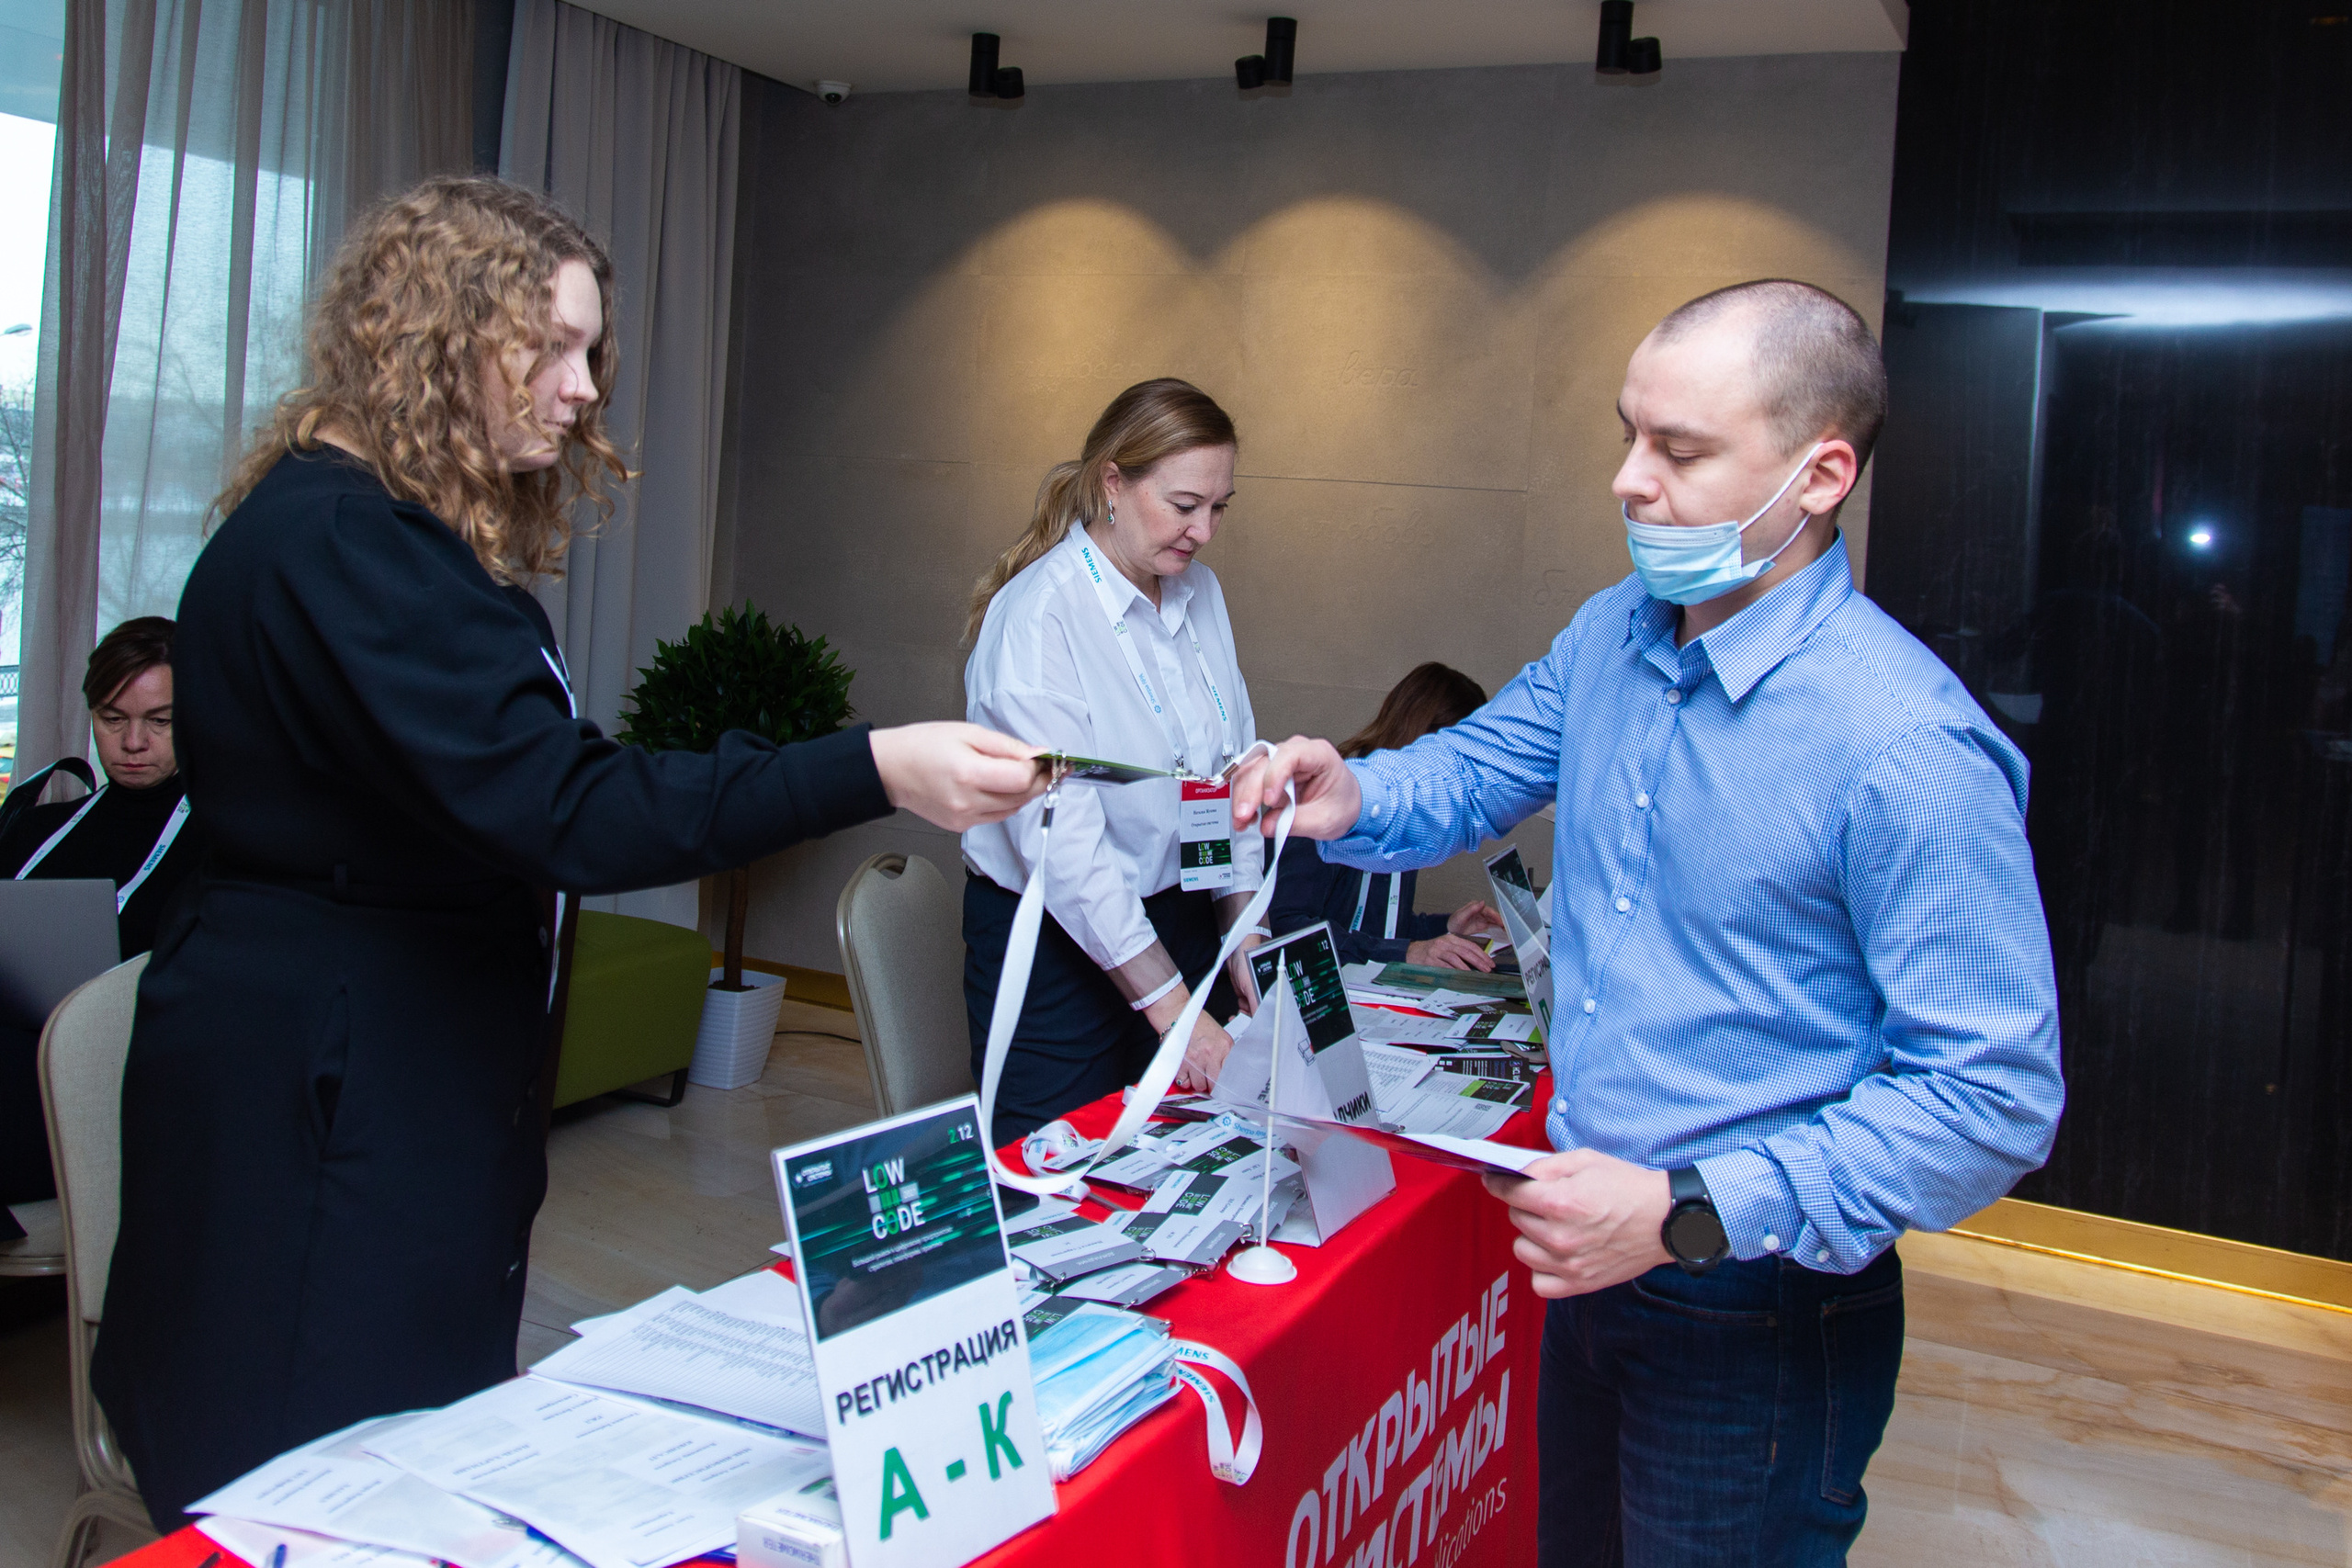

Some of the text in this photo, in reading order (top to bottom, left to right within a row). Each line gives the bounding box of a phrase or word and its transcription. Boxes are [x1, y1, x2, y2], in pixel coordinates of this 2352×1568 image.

[1081, 547, 1102, 584] SIEMENS
[1211, 684, 1227, 722] SIEMENS
[143, 843, 166, 872] SIEMENS
[1198, 842, 1210, 852] LOW
[1199, 855, 1214, 865] CODE
[1317, 940, 1329, 953] 2.12
[947, 1122, 975, 1145] 2.12
[1234, 1122, 1256, 1136] Sherpa
[862, 1156, 905, 1194] LOW
[1175, 1192, 1194, 1209] CODE
[1195, 1194, 1212, 1209] LOW
[872, 1201, 926, 1240] CODE
[1177, 1347, 1210, 1360] MENS
[837, 1318, 1019, 1426] РЕГИСТРАЦИЯ
[1177, 1368, 1216, 1404] SIEMEN
[1285, 1269, 1510, 1568] ОТКРЫТЫЕ
[880, 1390, 1024, 1541] А - К
[1344, 1368, 1510, 1568] ИСТЕМЫ
[1434, 1476, 1508, 1568] lications
